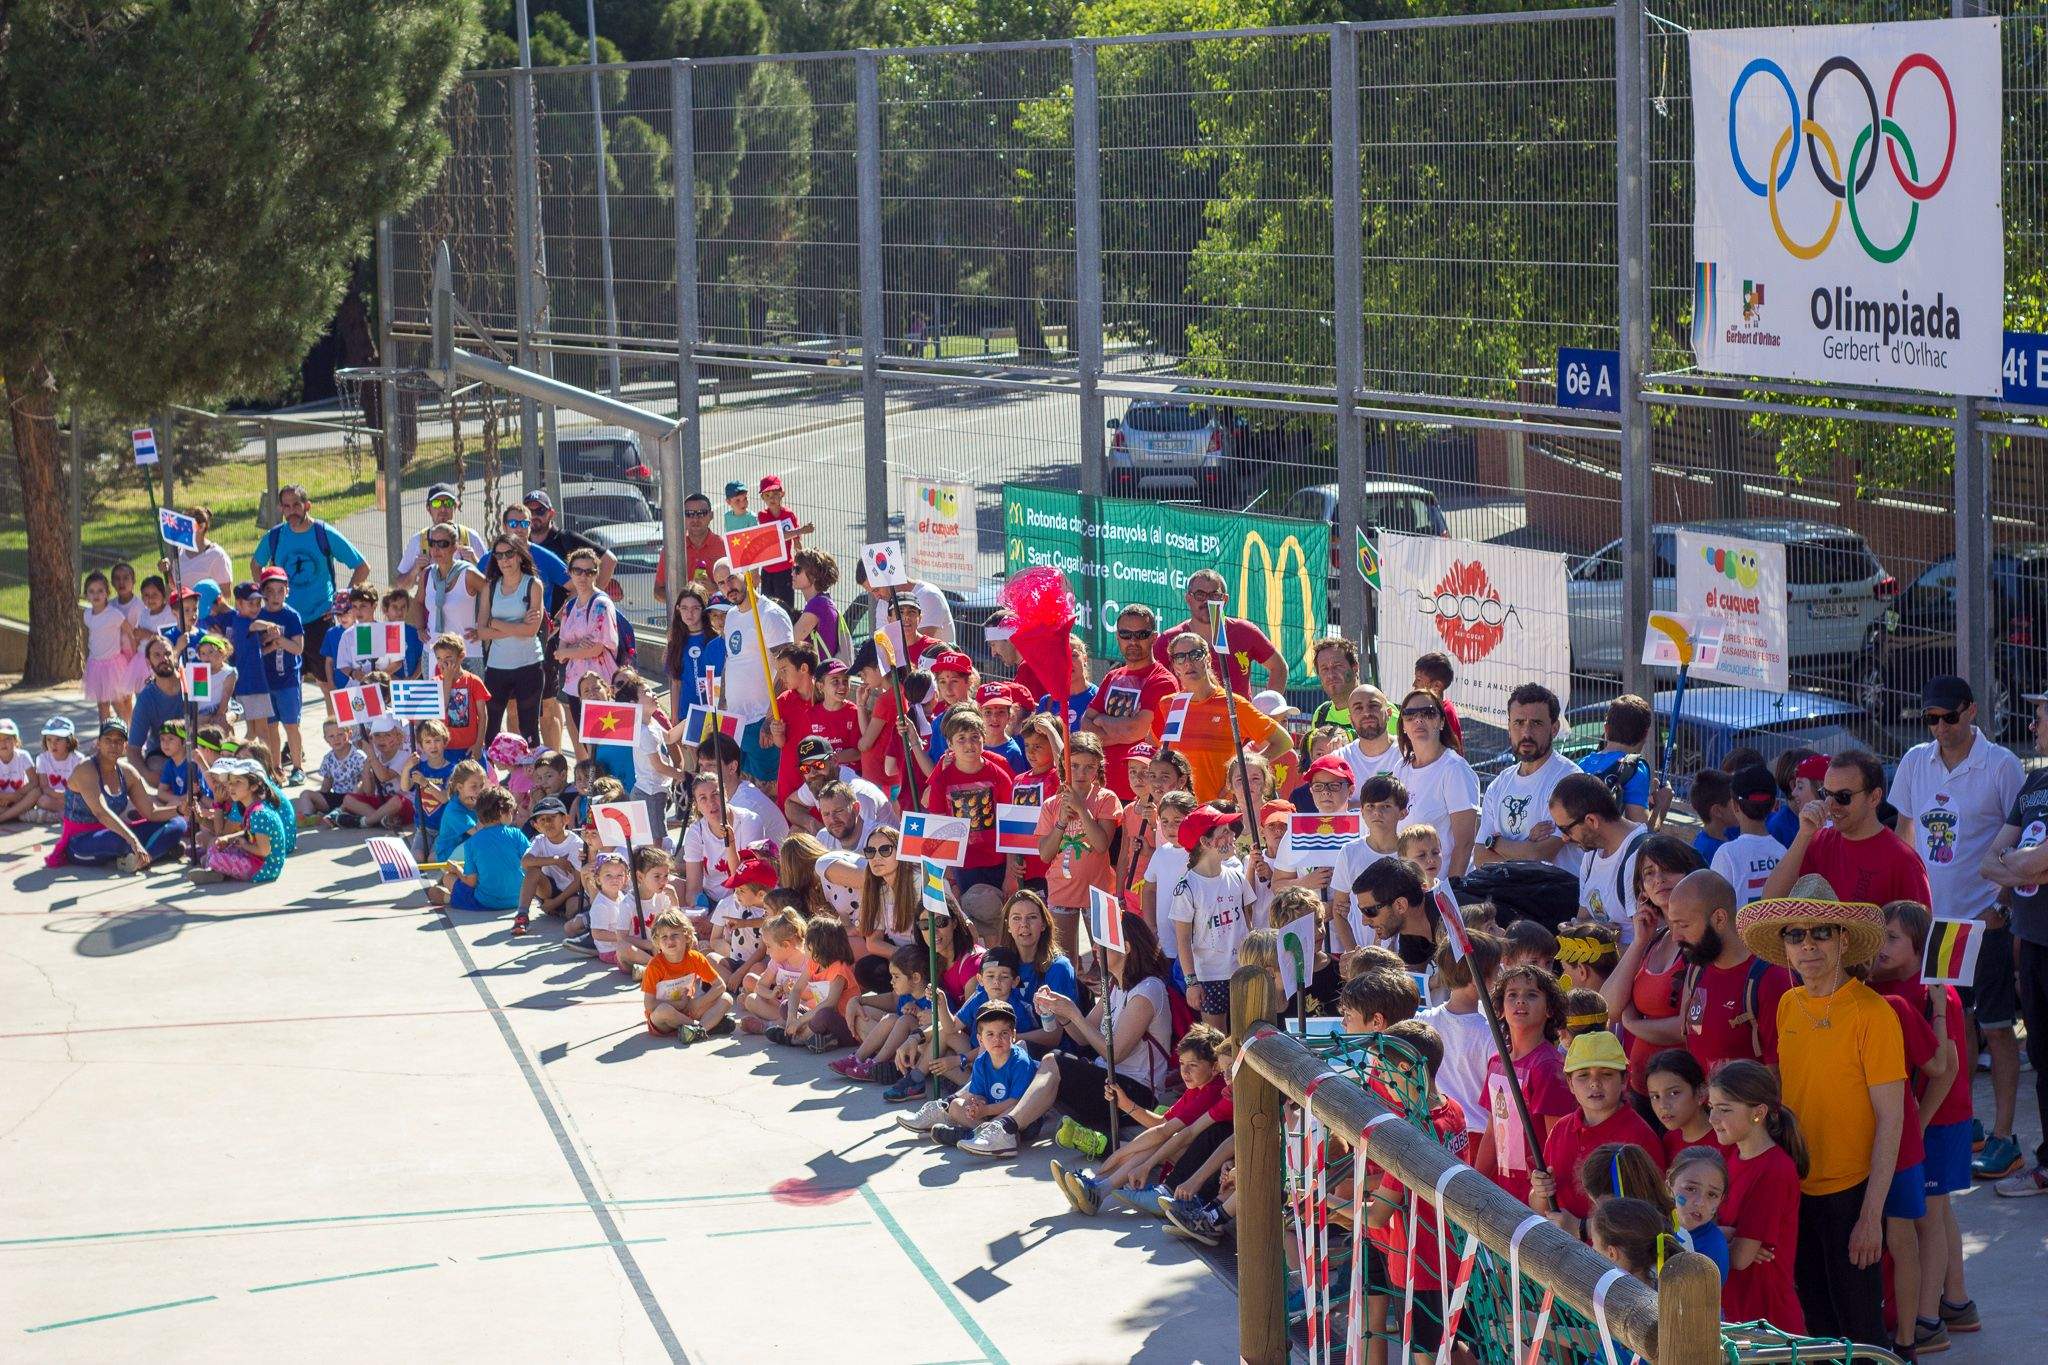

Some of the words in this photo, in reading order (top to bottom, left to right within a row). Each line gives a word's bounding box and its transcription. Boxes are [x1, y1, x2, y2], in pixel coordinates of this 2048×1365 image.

[1810, 285, 1961, 346] Olimpiada
[1822, 335, 1881, 363] Gerbert
[1890, 339, 1948, 369] d'Orlhac
[2002, 347, 2028, 388] 4t
[1566, 361, 1591, 396] 6è
[1595, 364, 1612, 397] A
[1026, 507, 1068, 531] Rotonda
[1150, 524, 1162, 546] (al
[1165, 532, 1200, 553] costat
[1027, 546, 1051, 566] Sant
[1053, 550, 1080, 574] Cugat
[1112, 560, 1168, 586] Comercial
[1706, 586, 1717, 609] el
[1719, 592, 1760, 617] cuquet
[1473, 680, 1483, 688] BE
